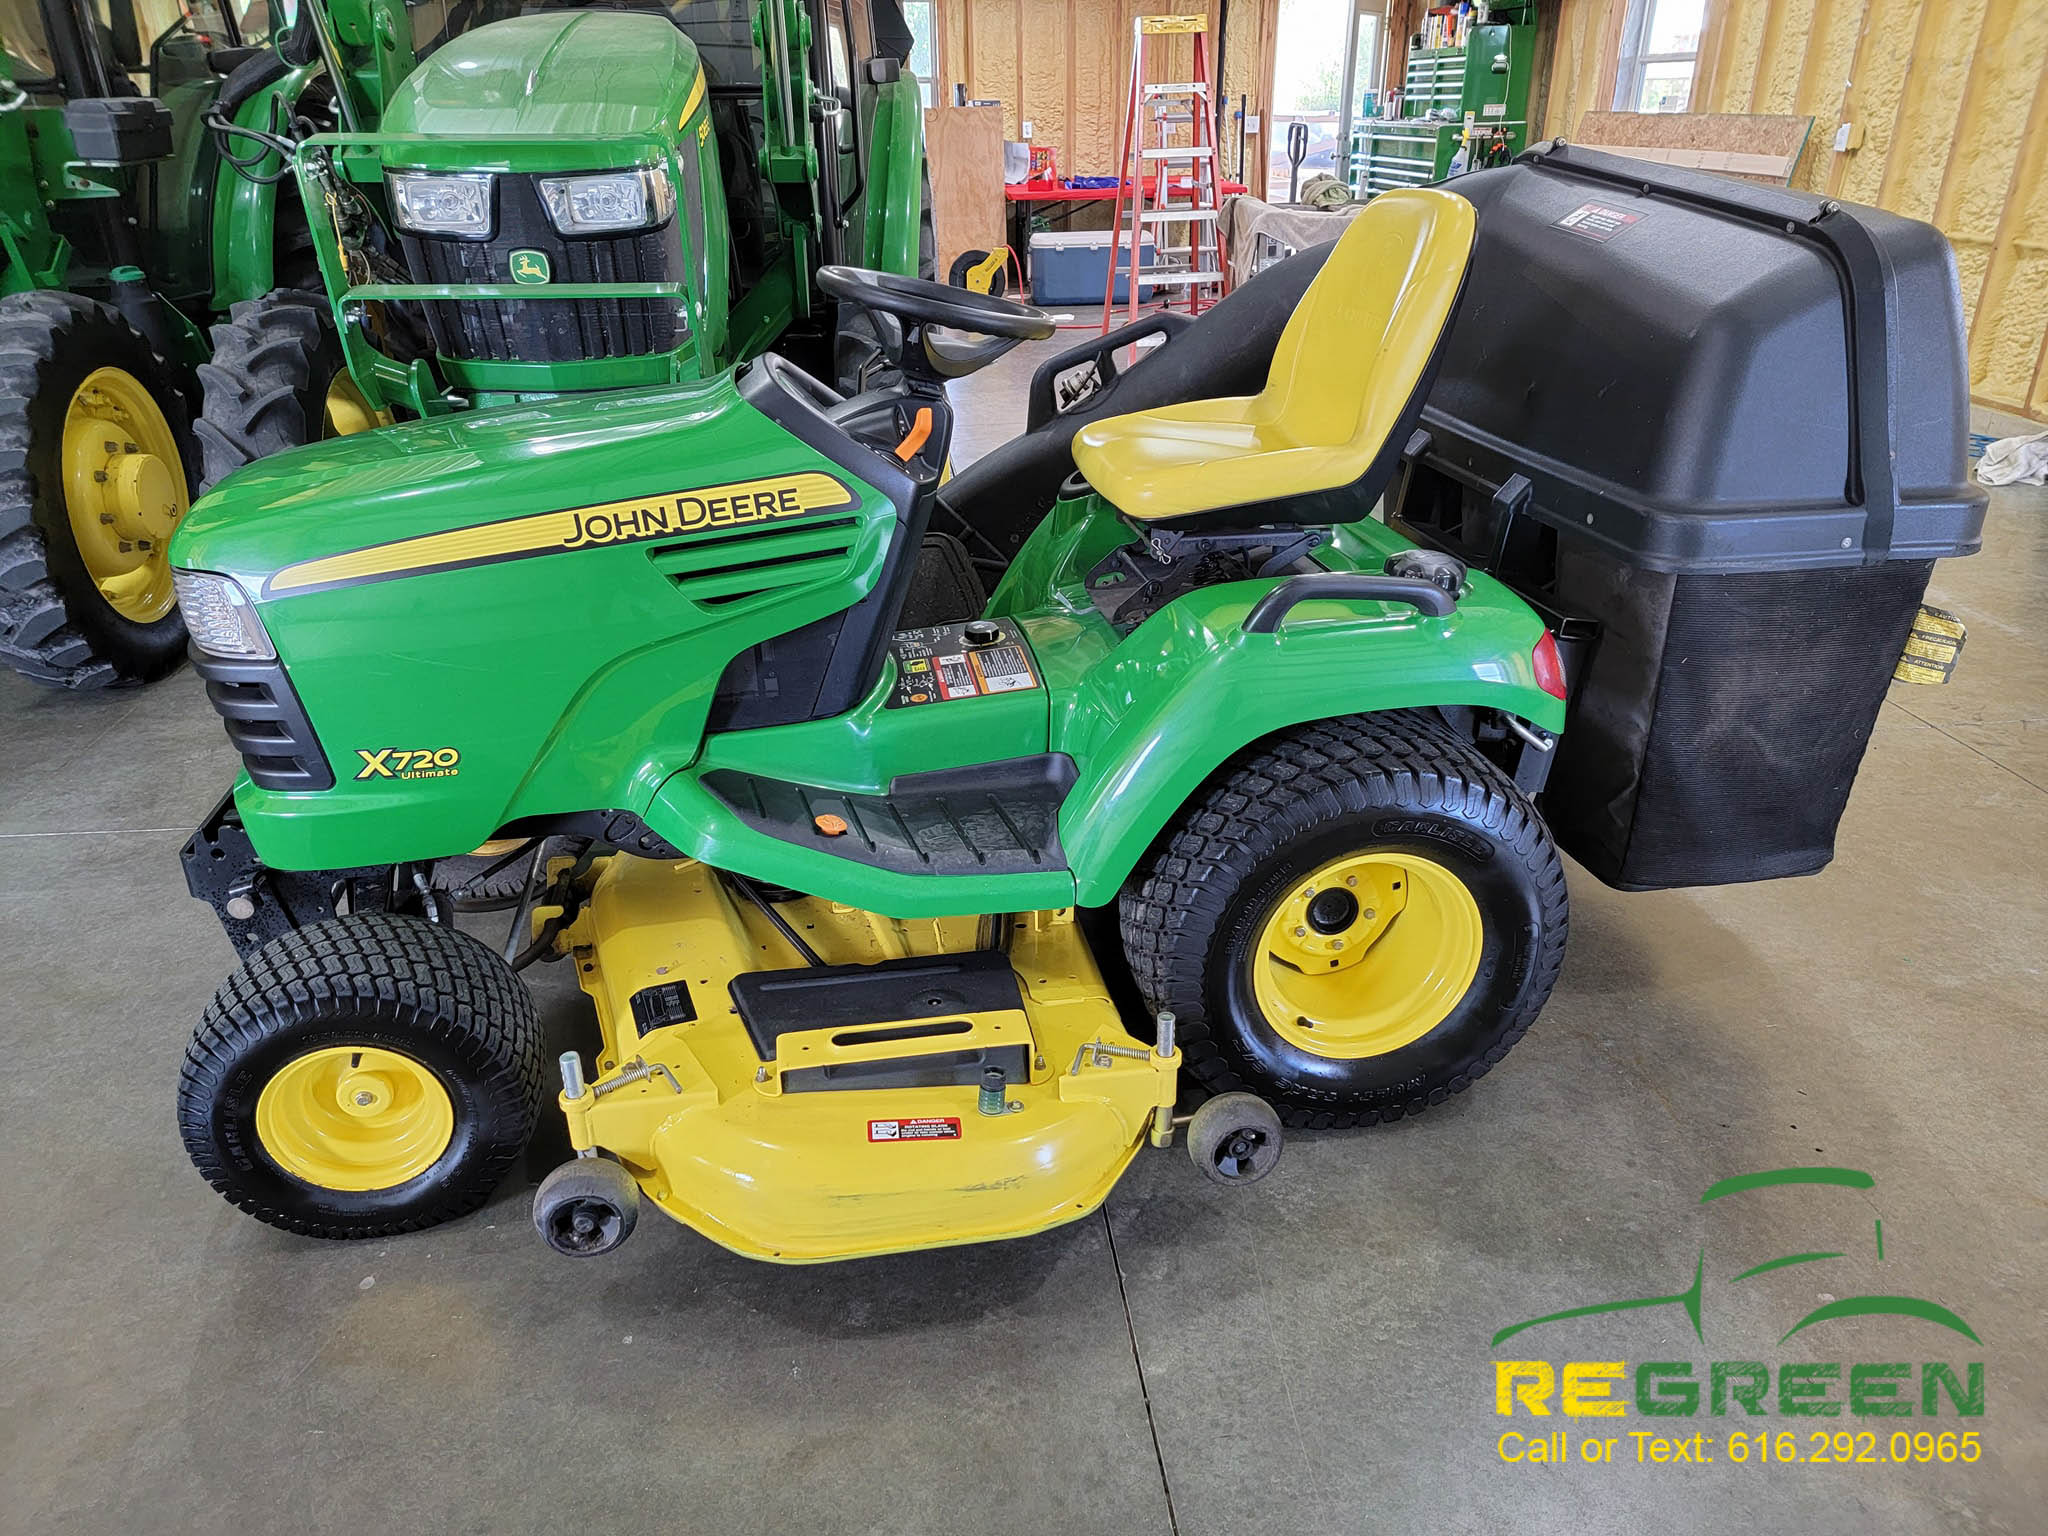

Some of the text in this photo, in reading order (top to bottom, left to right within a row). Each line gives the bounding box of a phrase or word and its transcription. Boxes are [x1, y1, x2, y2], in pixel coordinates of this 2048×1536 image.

[563, 487, 803, 545] JOHN DEERE
[353, 747, 460, 780] X720
[401, 768, 459, 780] Ultimate
